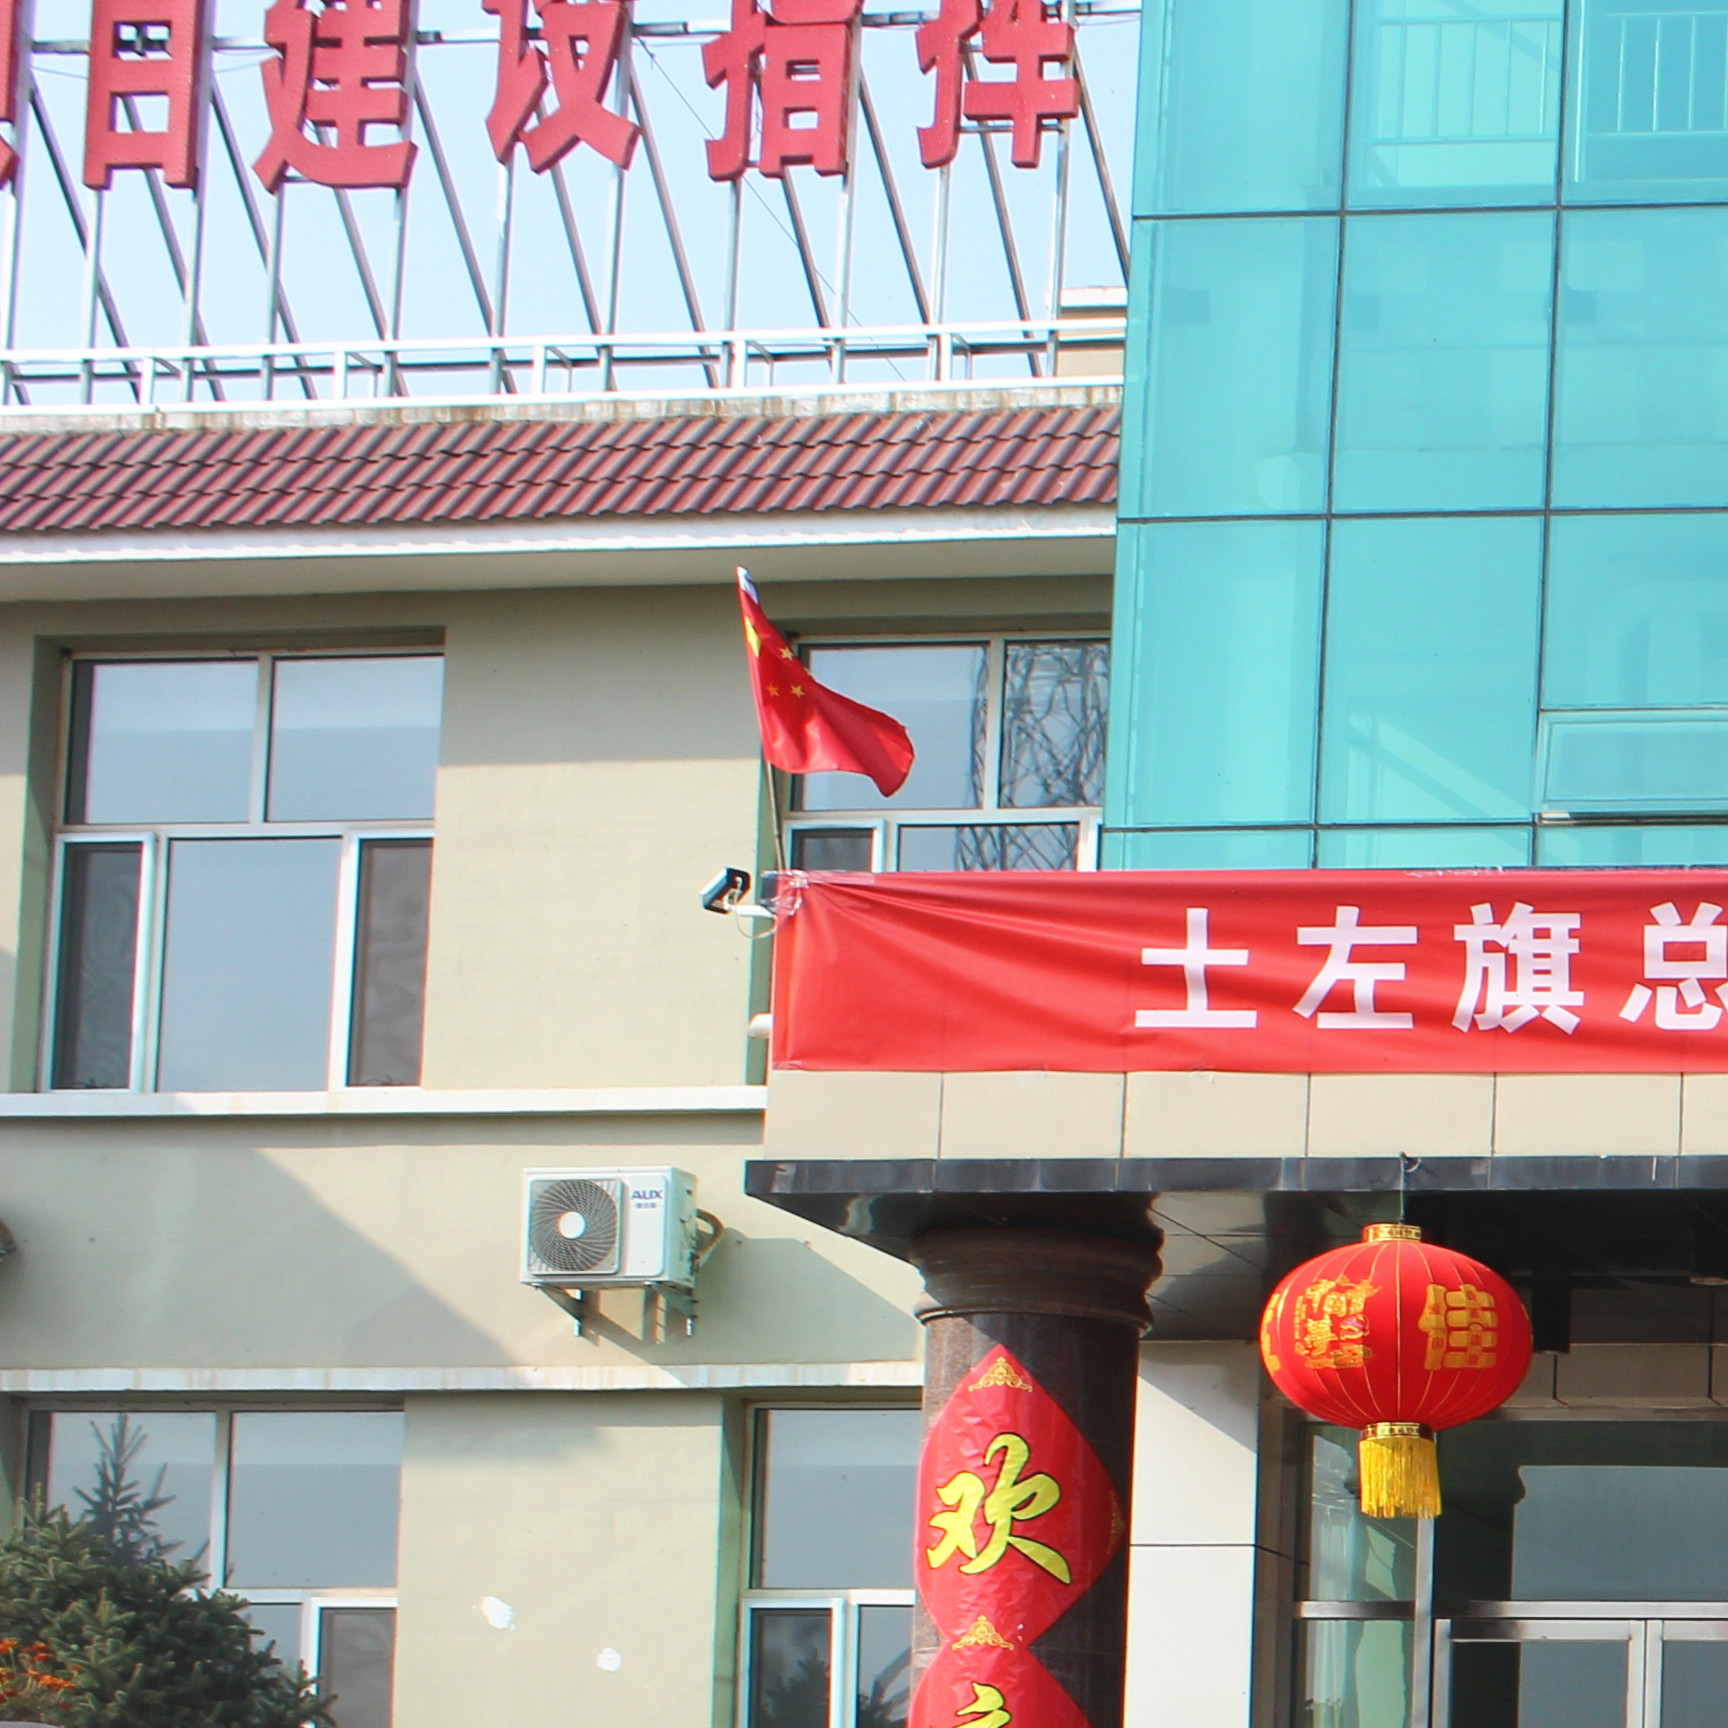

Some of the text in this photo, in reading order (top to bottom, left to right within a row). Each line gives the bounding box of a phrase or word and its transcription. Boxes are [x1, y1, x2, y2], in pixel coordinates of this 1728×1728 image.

[0, 0, 1078, 192] 目建设指挥
[631, 1189, 663, 1200] AUX
